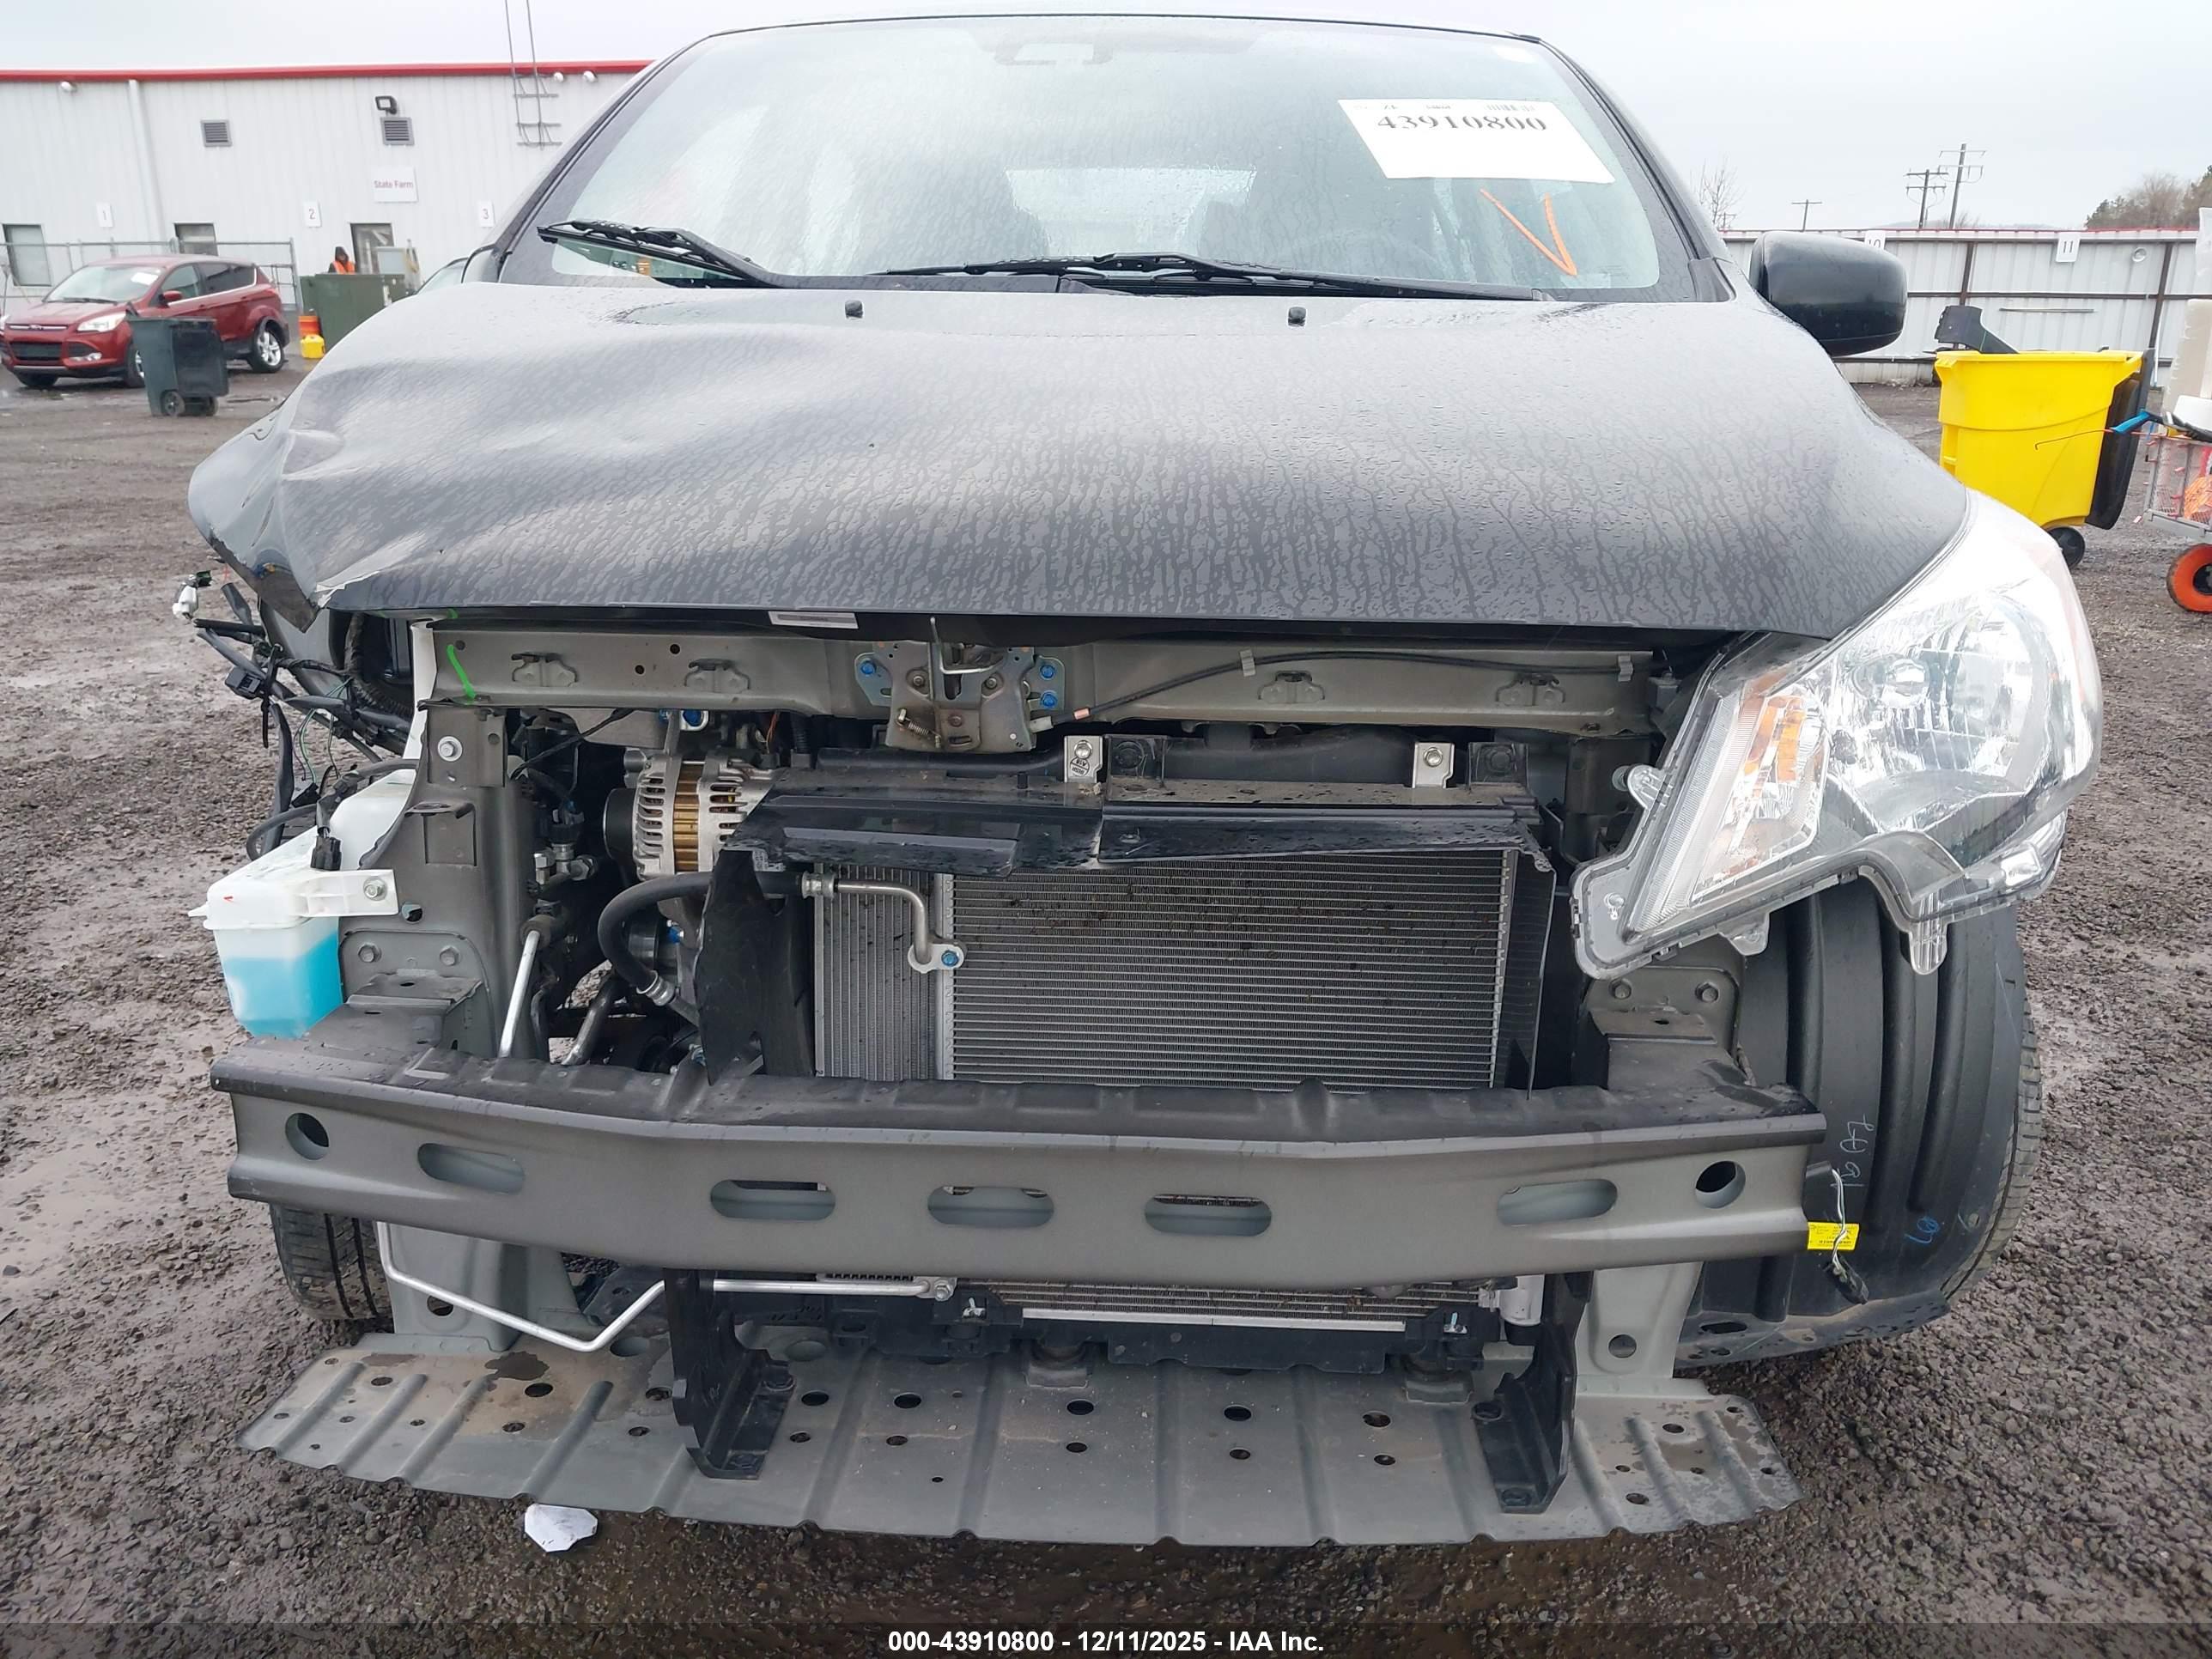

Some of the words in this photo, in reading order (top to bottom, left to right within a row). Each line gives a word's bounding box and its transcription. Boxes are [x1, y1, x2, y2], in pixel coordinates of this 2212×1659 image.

[1377, 115, 1547, 131] 43910800
[374, 179, 393, 189] State
[394, 179, 414, 189] Farm
[308, 208, 316, 220] 2
[482, 208, 489, 220] 3
[2063, 240, 2074, 253] 11
